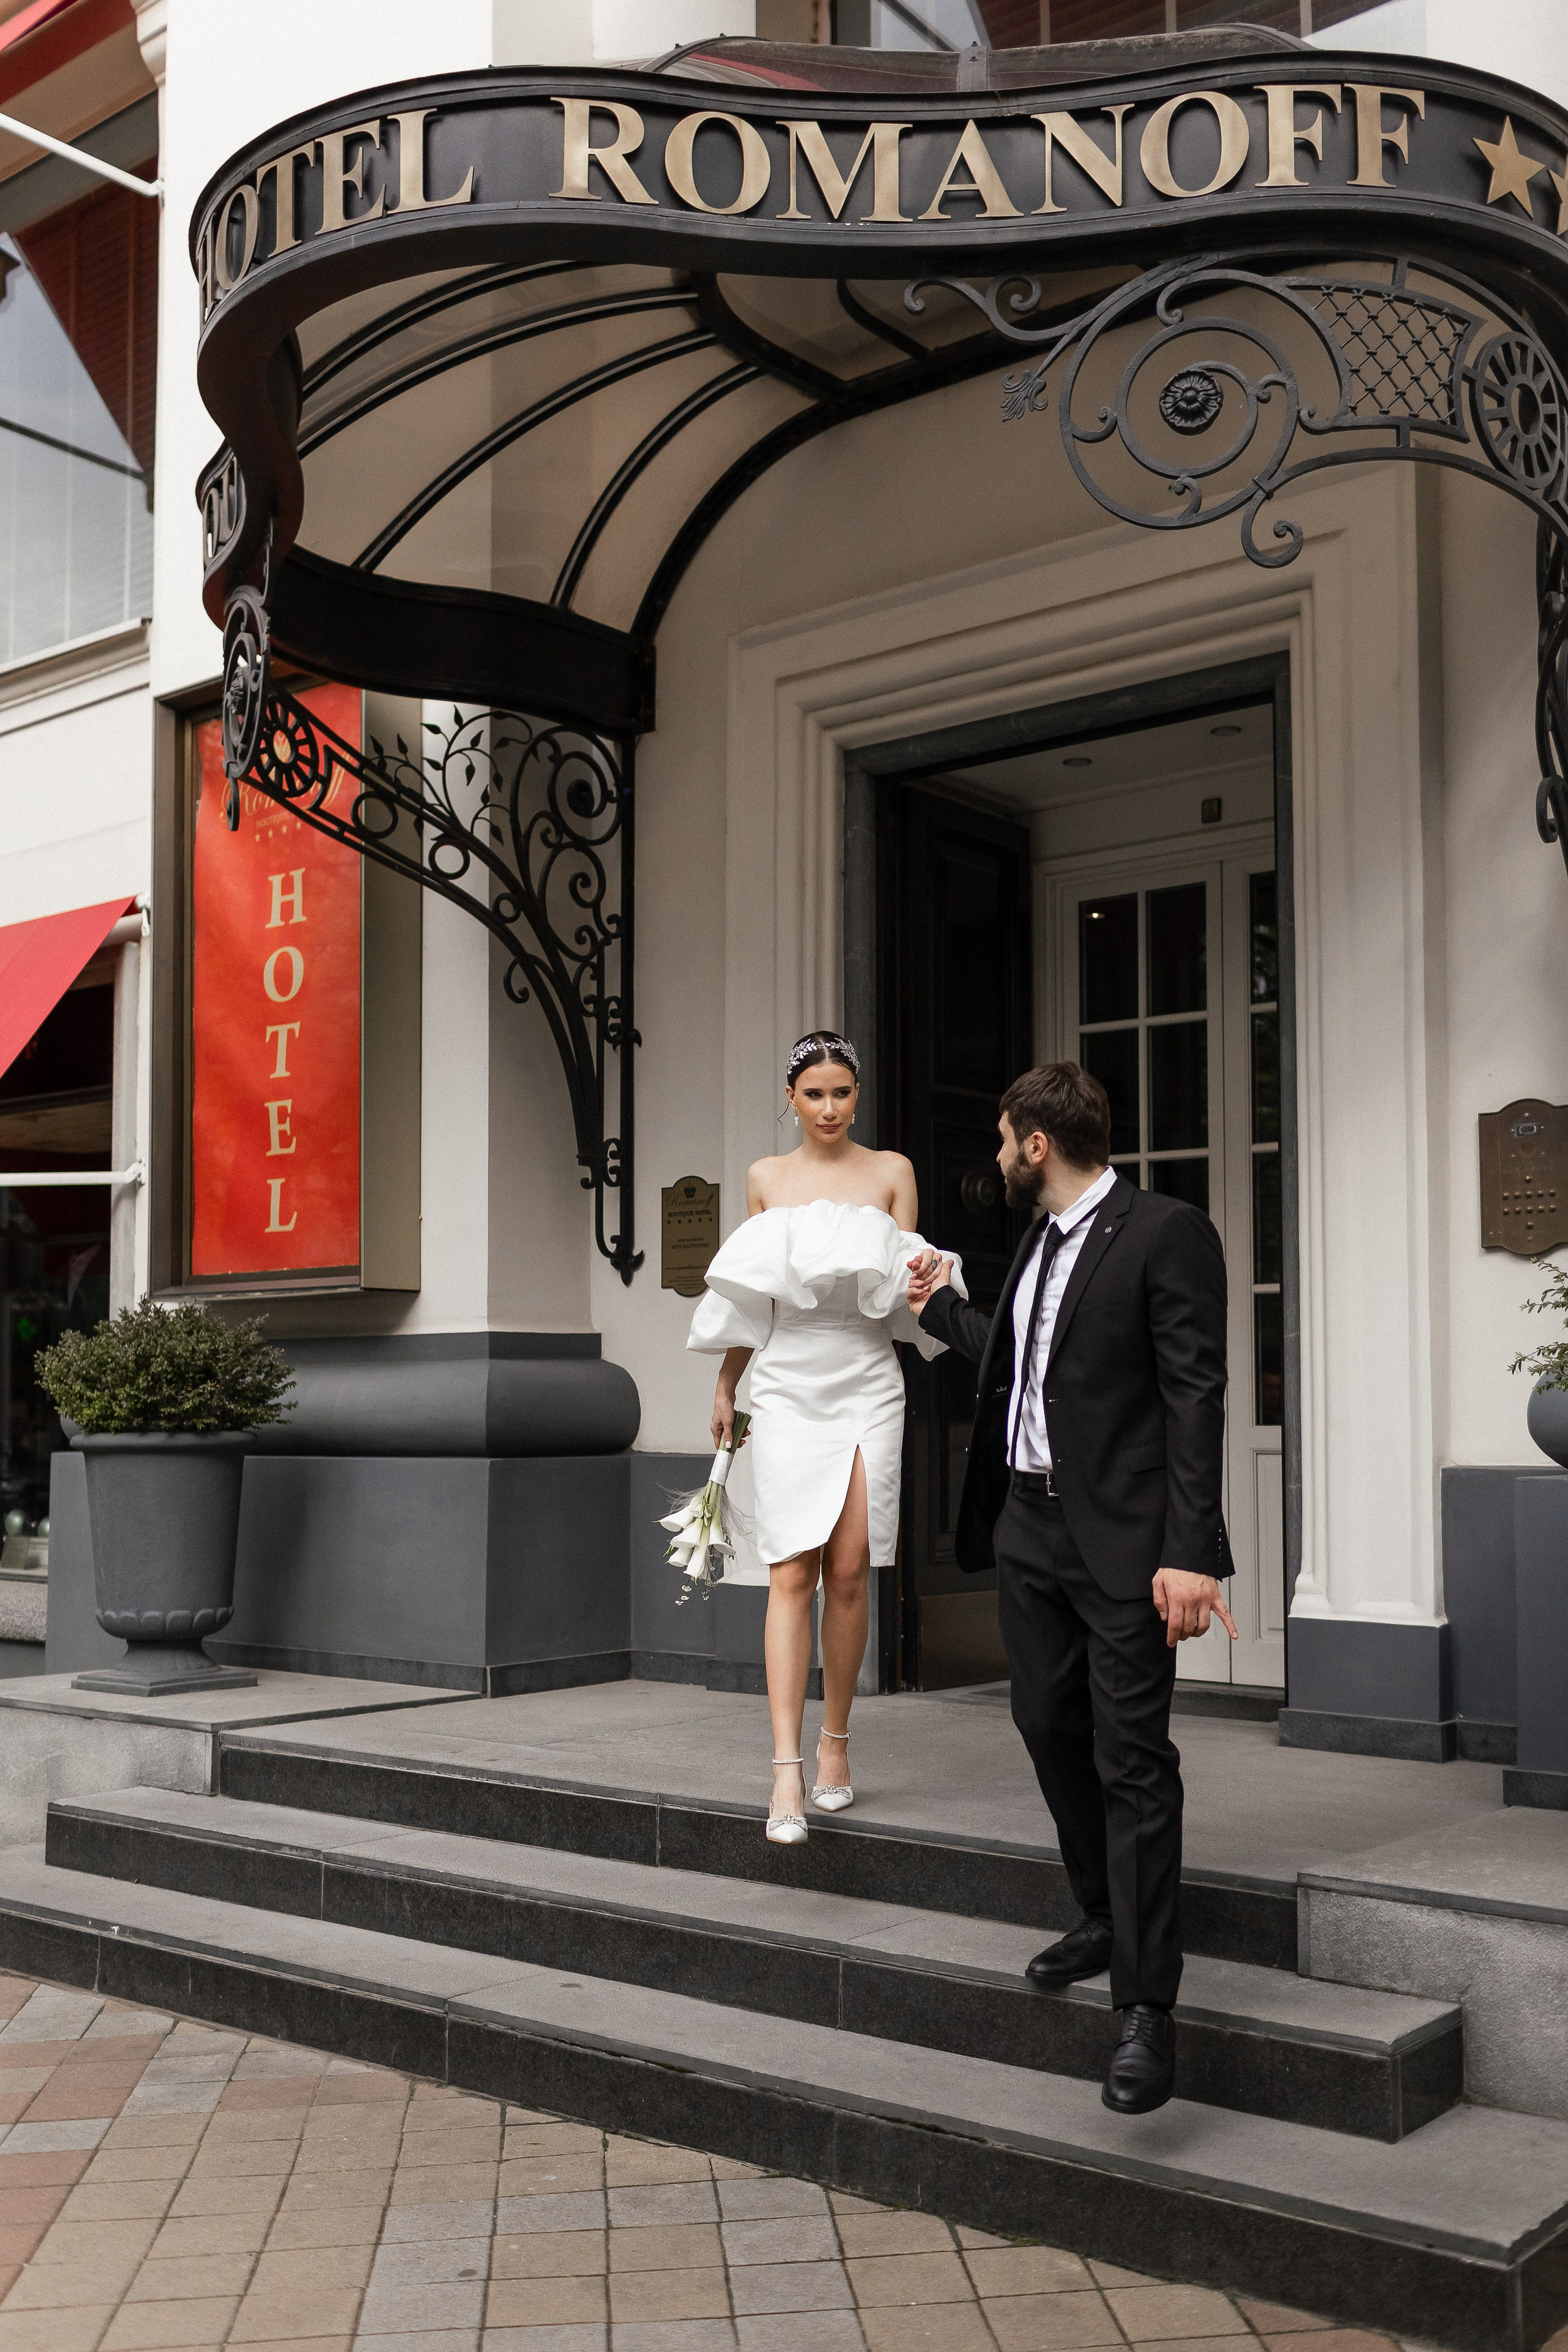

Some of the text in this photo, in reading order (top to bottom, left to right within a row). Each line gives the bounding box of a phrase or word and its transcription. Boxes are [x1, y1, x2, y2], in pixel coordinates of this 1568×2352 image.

[196, 83, 1425, 331] HOTEL ROMANOFF
[263, 867, 307, 1234] HOTEL
[665, 1192, 714, 1208] Romanoff
